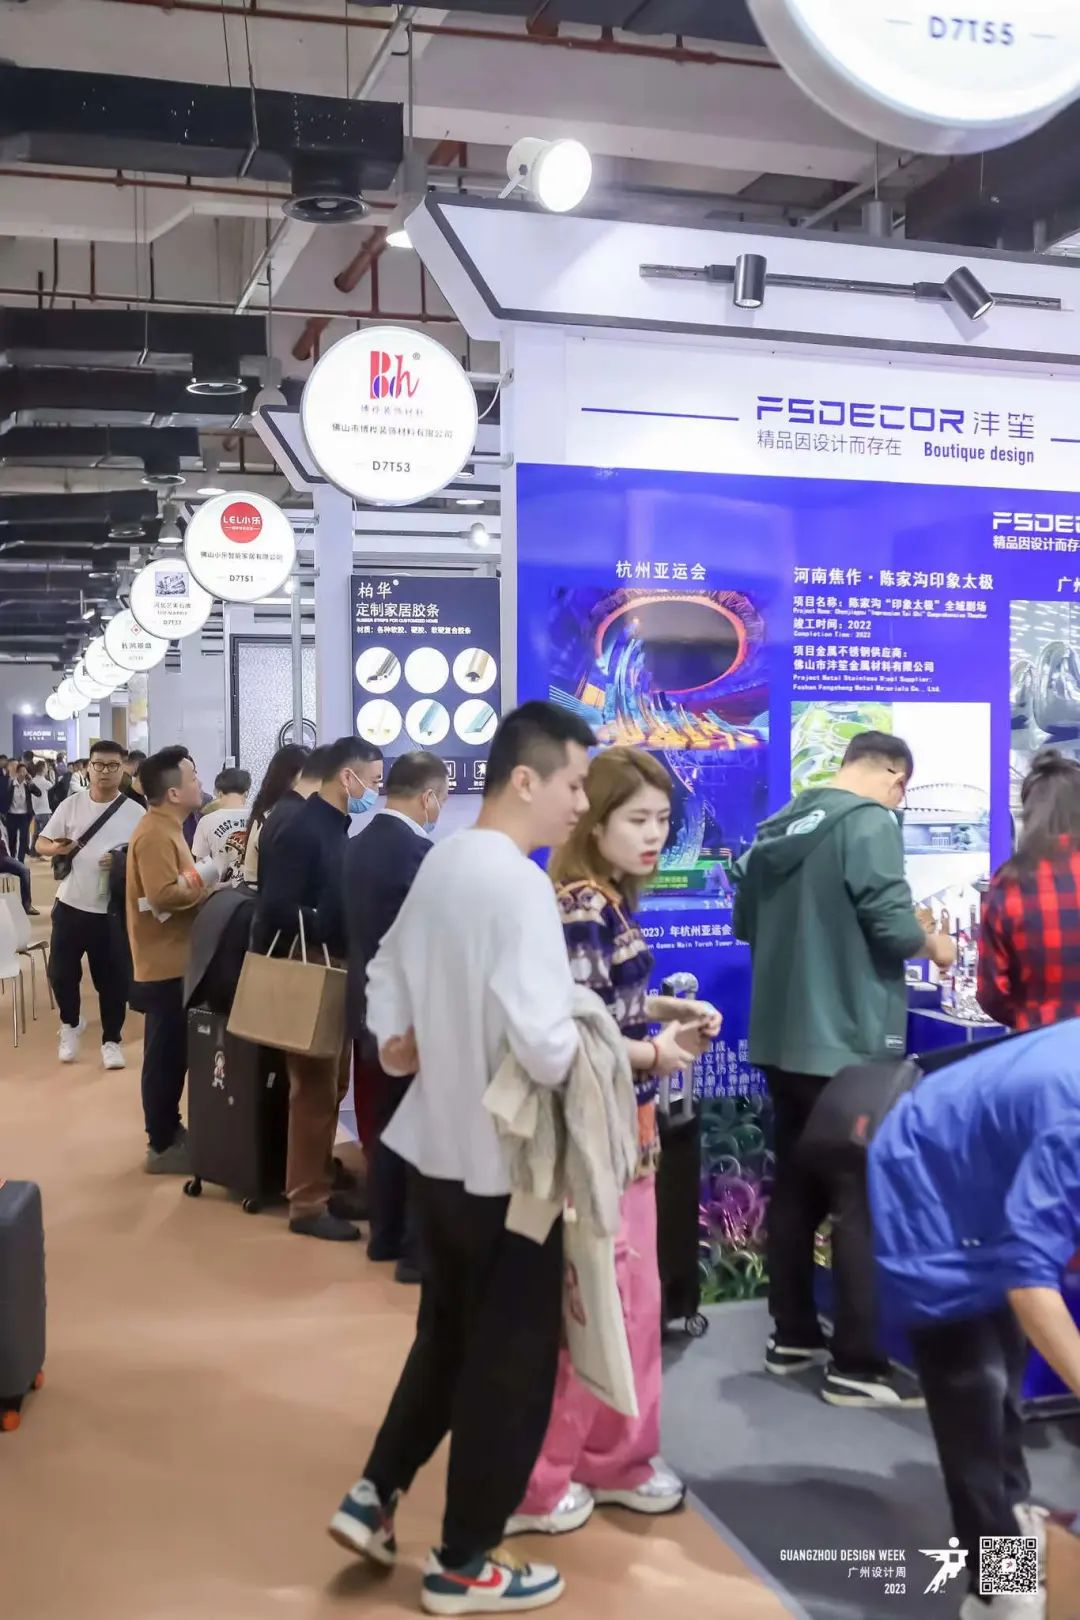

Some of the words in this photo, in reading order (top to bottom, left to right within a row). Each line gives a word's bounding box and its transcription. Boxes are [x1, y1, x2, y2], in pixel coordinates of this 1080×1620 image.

[929, 16, 1014, 45] D7T55
[757, 396, 964, 434] FSDECOR
[973, 411, 1034, 439] 沣笙
[757, 429, 902, 456] 精品因设计而存在
[924, 441, 985, 461] Boutique
[990, 446, 1034, 465] design
[372, 461, 411, 473] D7T53
[992, 511, 1080, 533] FSDE
[616, 560, 706, 580] 杭州亚运会
[357, 581, 392, 599] 柏华
[356, 602, 440, 617] 定制家居胶条
